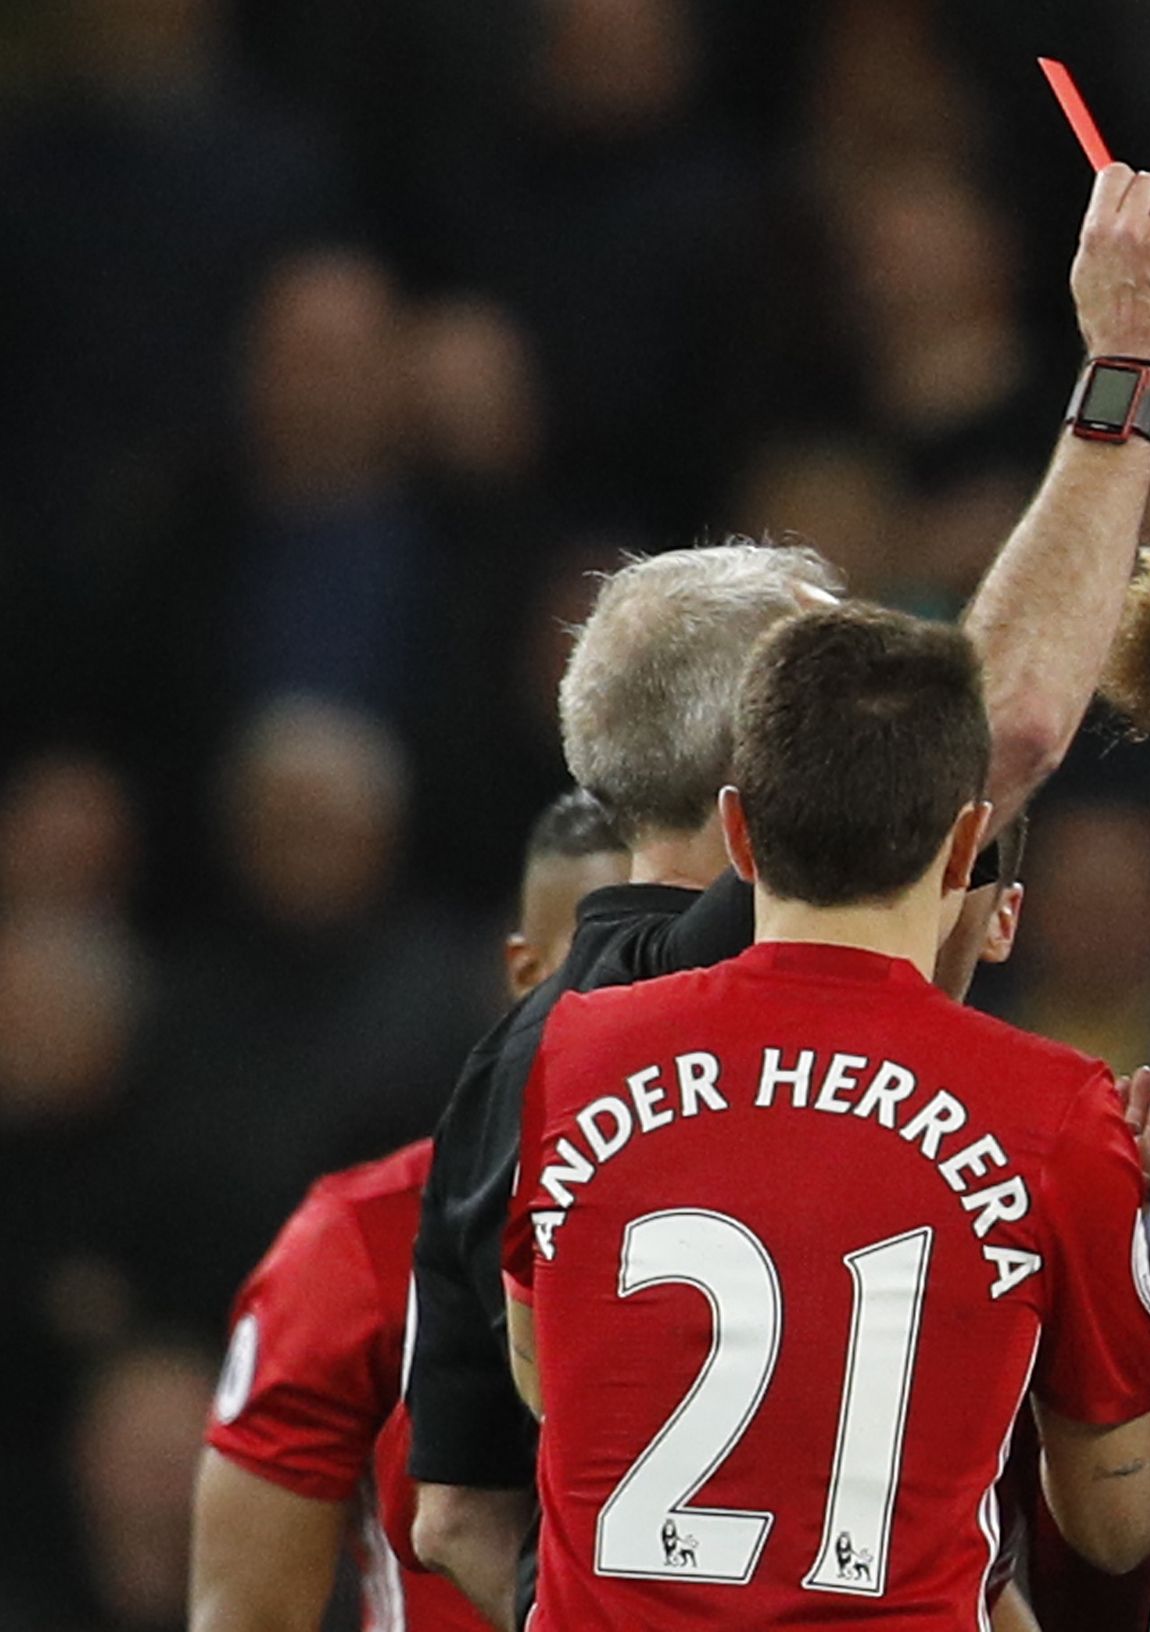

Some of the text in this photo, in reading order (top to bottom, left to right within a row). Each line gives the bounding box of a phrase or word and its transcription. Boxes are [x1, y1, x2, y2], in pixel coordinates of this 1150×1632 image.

[531, 1048, 1042, 1299] ANDER HERRERA
[593, 1208, 932, 1597] 21
